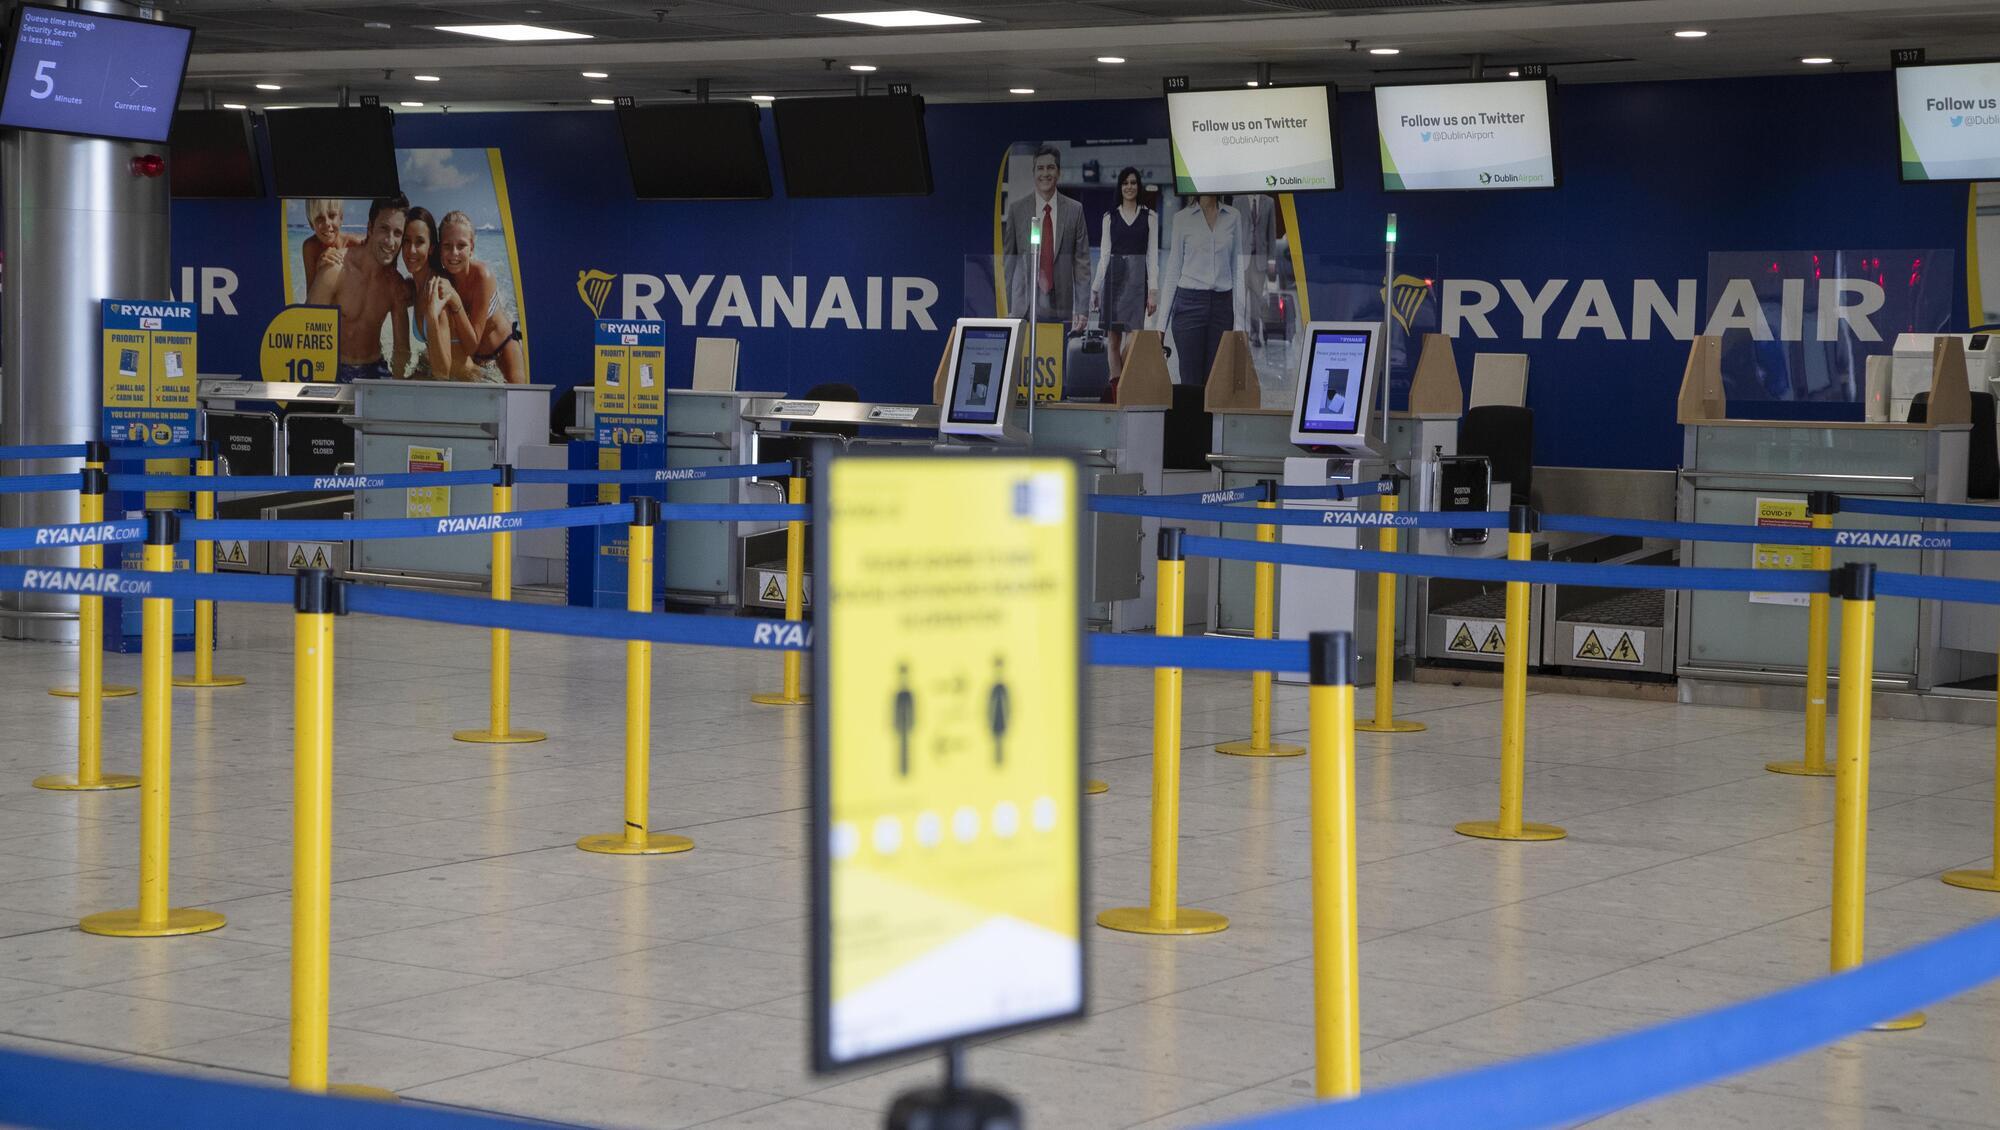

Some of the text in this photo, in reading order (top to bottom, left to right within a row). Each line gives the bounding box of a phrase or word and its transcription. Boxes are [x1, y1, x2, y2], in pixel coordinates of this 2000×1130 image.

[25, 13, 96, 30] Queue time through
[22, 24, 77, 38] Security Search
[28, 36, 43, 44] less
[1898, 51, 1918, 60] 1317
[30, 60, 56, 99] 5
[1168, 78, 1184, 88] 1315
[55, 95, 82, 104] Minutes
[1926, 98, 1997, 111] Follow us
[114, 101, 157, 112] Current time
[1192, 117, 1308, 132] Follow us on Twitter
[1401, 112, 1525, 127] Follow us on Twitter
[1222, 135, 1279, 145] @DublinAirport
[1432, 131, 1494, 142] @DublinAirport
[622, 273, 939, 331] RYANAIR
[121, 305, 191, 318] RYANAIR
[1441, 278, 1886, 342] RYANAIR
[305, 322, 333, 332] FAMILY
[607, 323, 660, 334] RYANAIR
[112, 334, 144, 343] PRIORITY
[269, 334, 333, 350] LOW FARES
[655, 469, 706, 481] RYANAIR.COM
[313, 477, 384, 489] RYANAIR.COM
[437, 515, 522, 533] RYANAIR.COM
[1322, 511, 1418, 526] RYANAIR.COM
[36, 526, 139, 545] RYANAIR.COM
[1835, 531, 1951, 548] RYANAIR.COM
[23, 569, 151, 594] RYANAIR.COM
